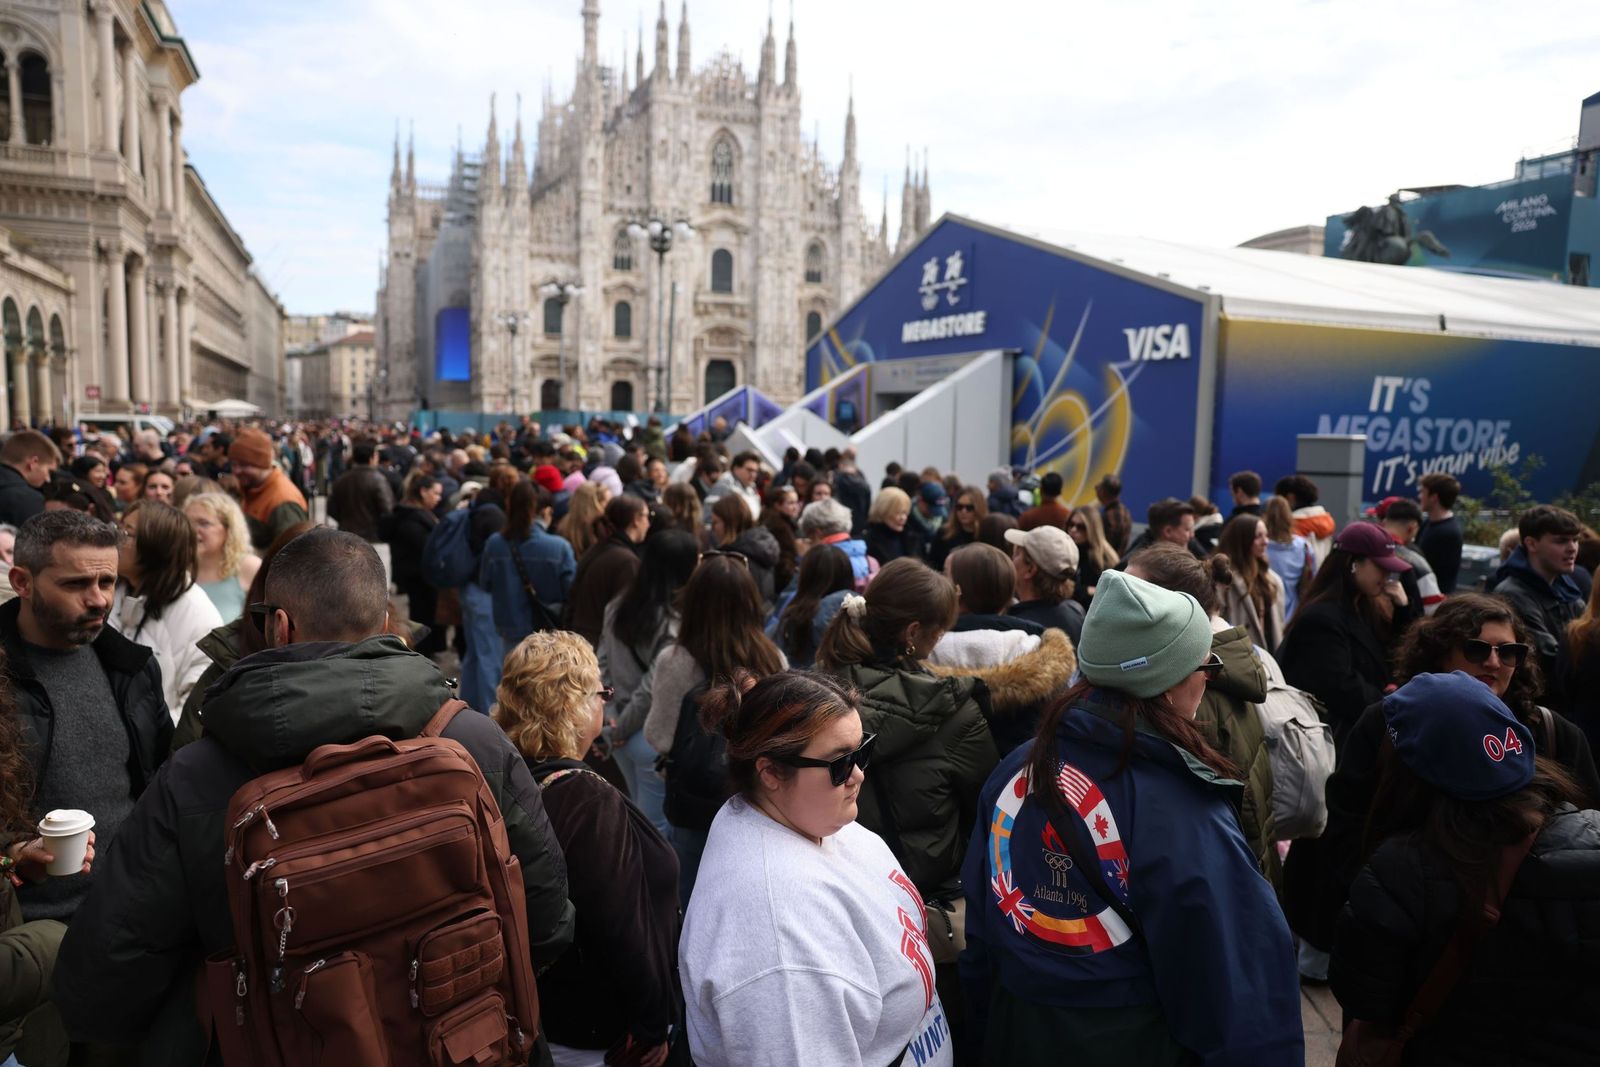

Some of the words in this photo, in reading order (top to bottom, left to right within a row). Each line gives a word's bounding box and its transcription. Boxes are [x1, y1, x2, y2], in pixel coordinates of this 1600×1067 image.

[902, 311, 985, 343] MEGASTORE
[1122, 323, 1191, 361] VISA
[1368, 375, 1431, 413] IT'S
[1483, 726, 1523, 762] 04
[1033, 883, 1063, 903] Atlanta
[1066, 890, 1088, 909] 1996
